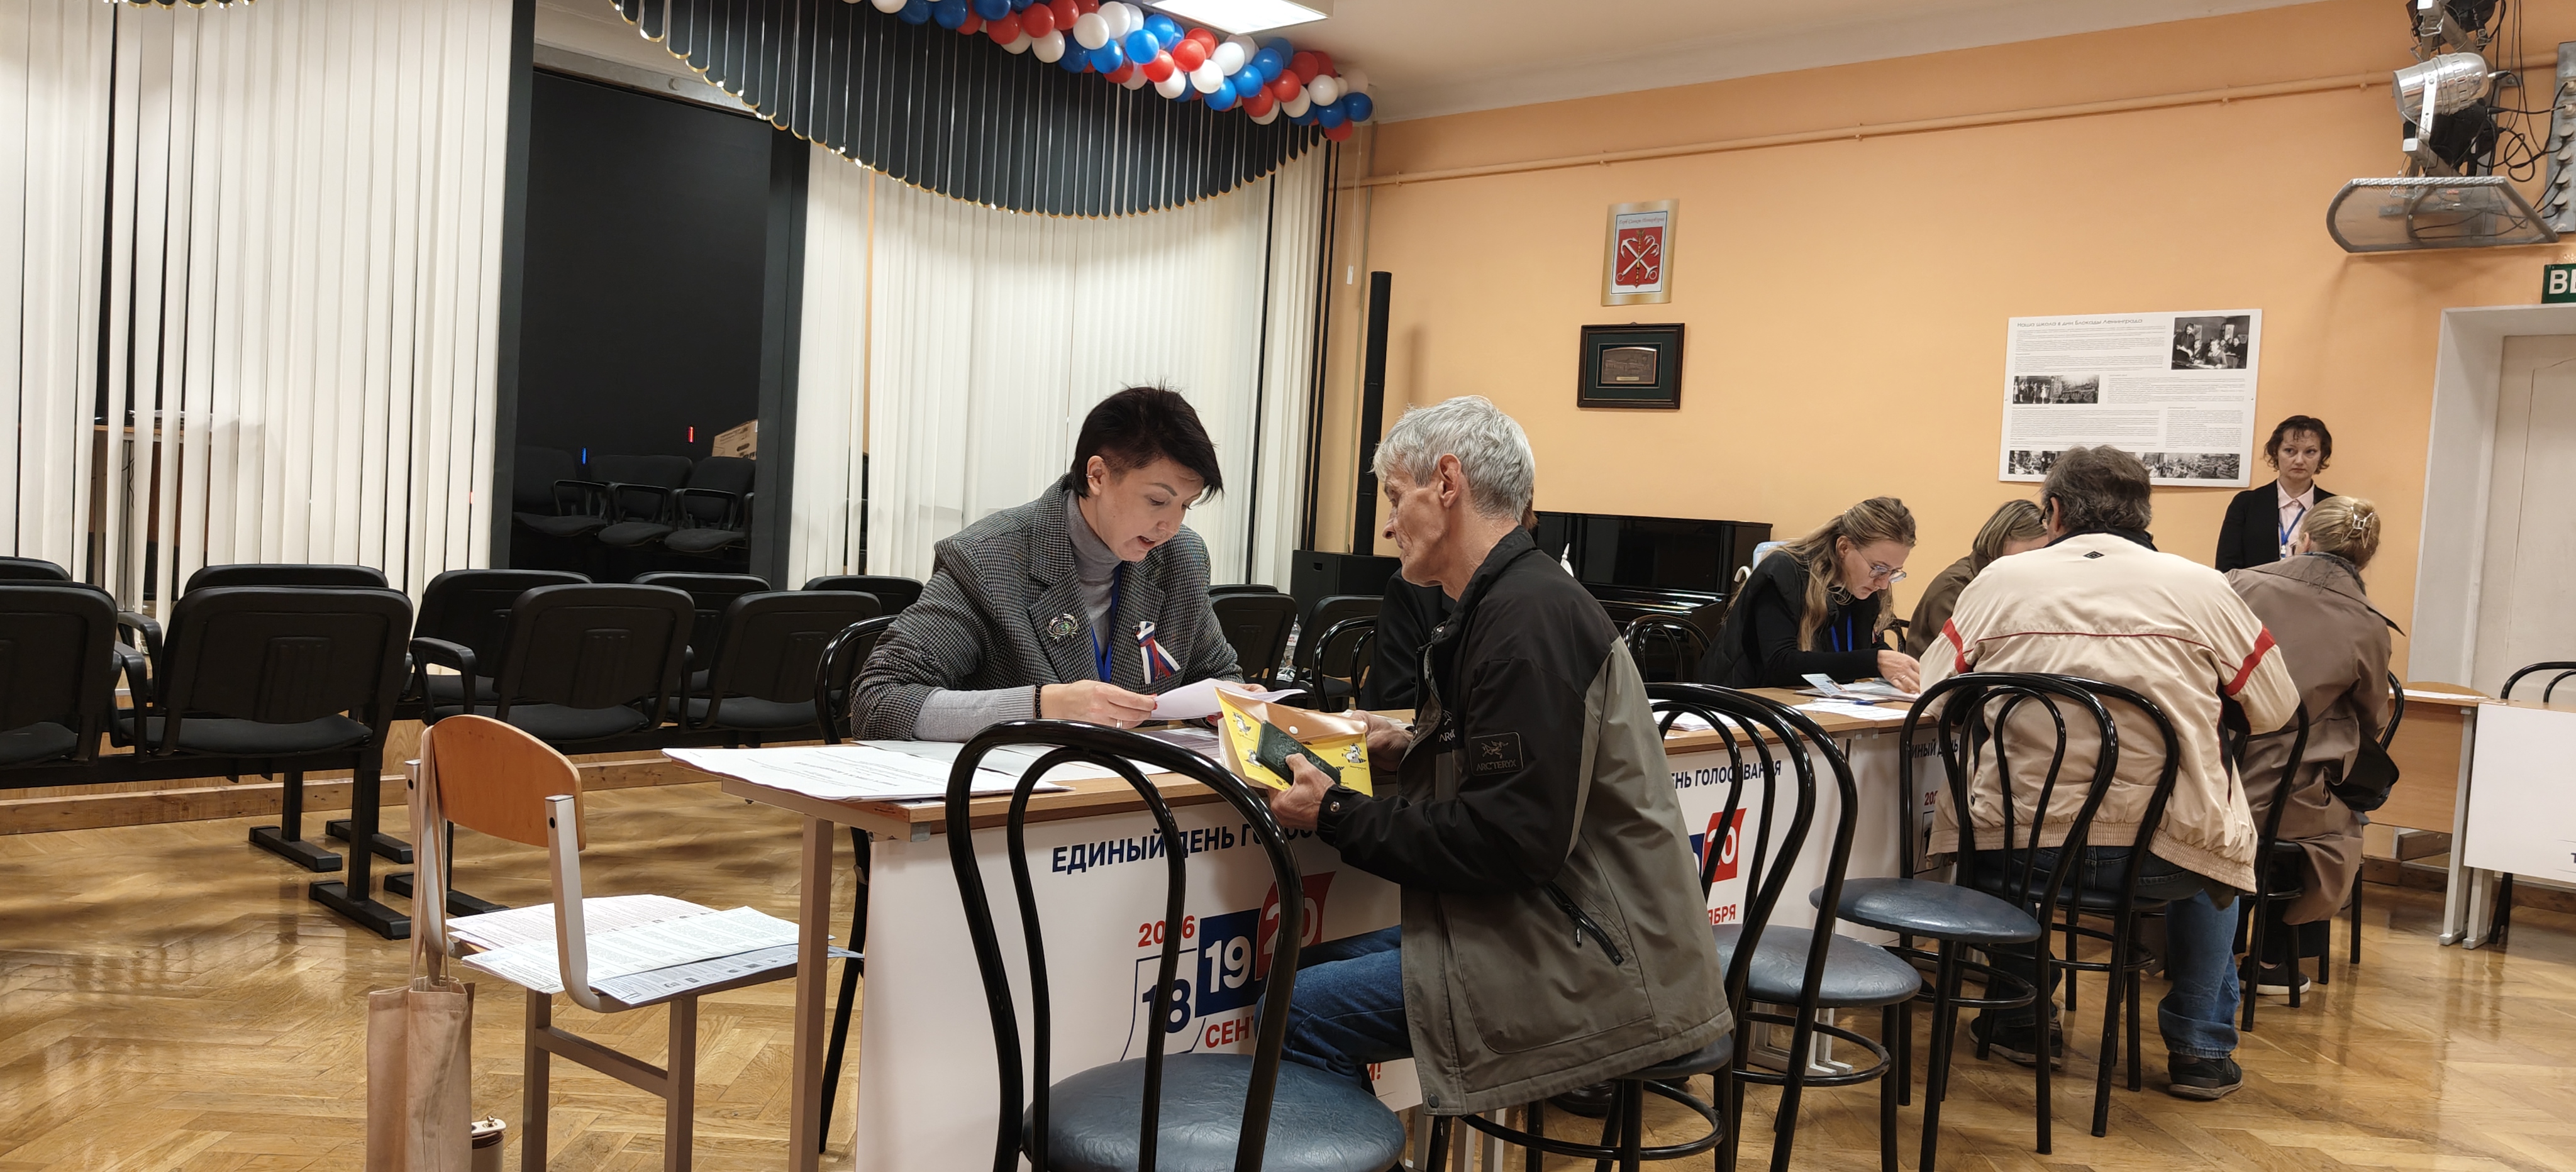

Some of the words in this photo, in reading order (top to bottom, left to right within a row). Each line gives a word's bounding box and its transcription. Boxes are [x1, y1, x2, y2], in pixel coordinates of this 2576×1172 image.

[1052, 828, 1164, 875] ЕДИНЫЙ
[1138, 915, 1195, 948] 206
[1205, 936, 1252, 993] 19
